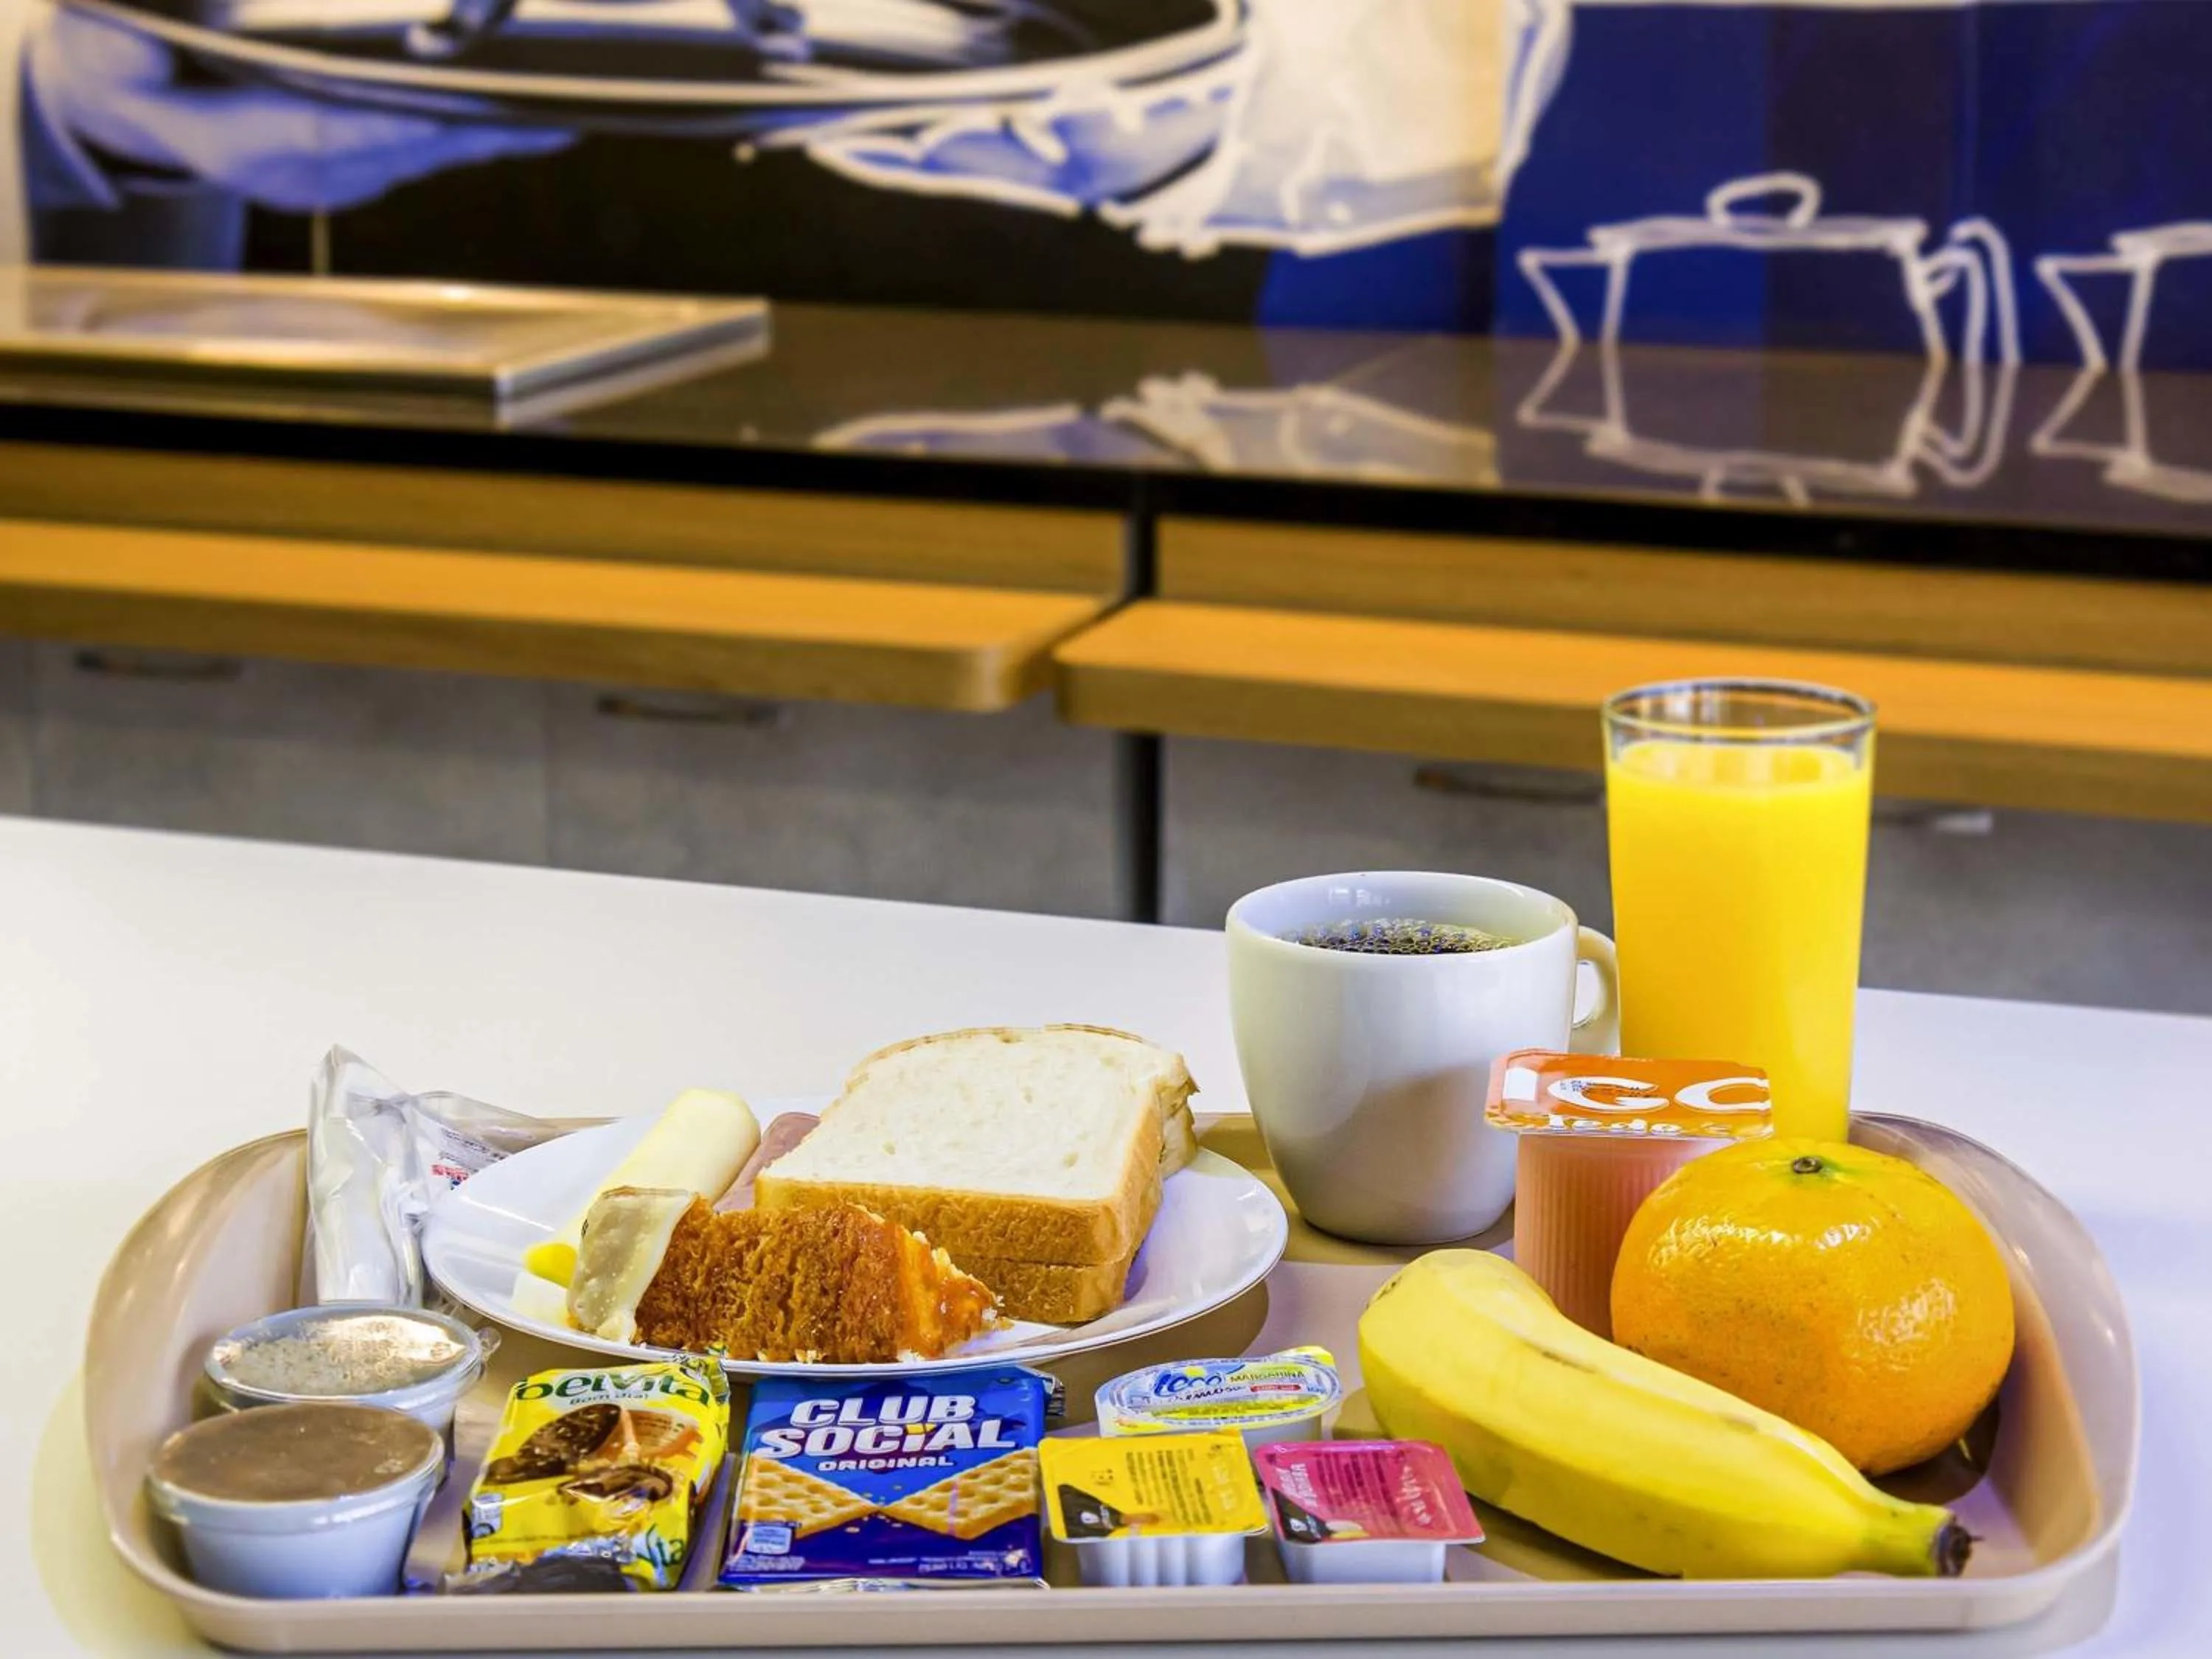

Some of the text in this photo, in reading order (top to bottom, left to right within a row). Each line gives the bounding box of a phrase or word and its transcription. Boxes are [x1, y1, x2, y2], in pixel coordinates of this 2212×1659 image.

[790, 1395, 975, 1428] CLUB
[754, 1419, 1016, 1459] SOCIAL
[817, 1455, 956, 1472] ORIGINAL
